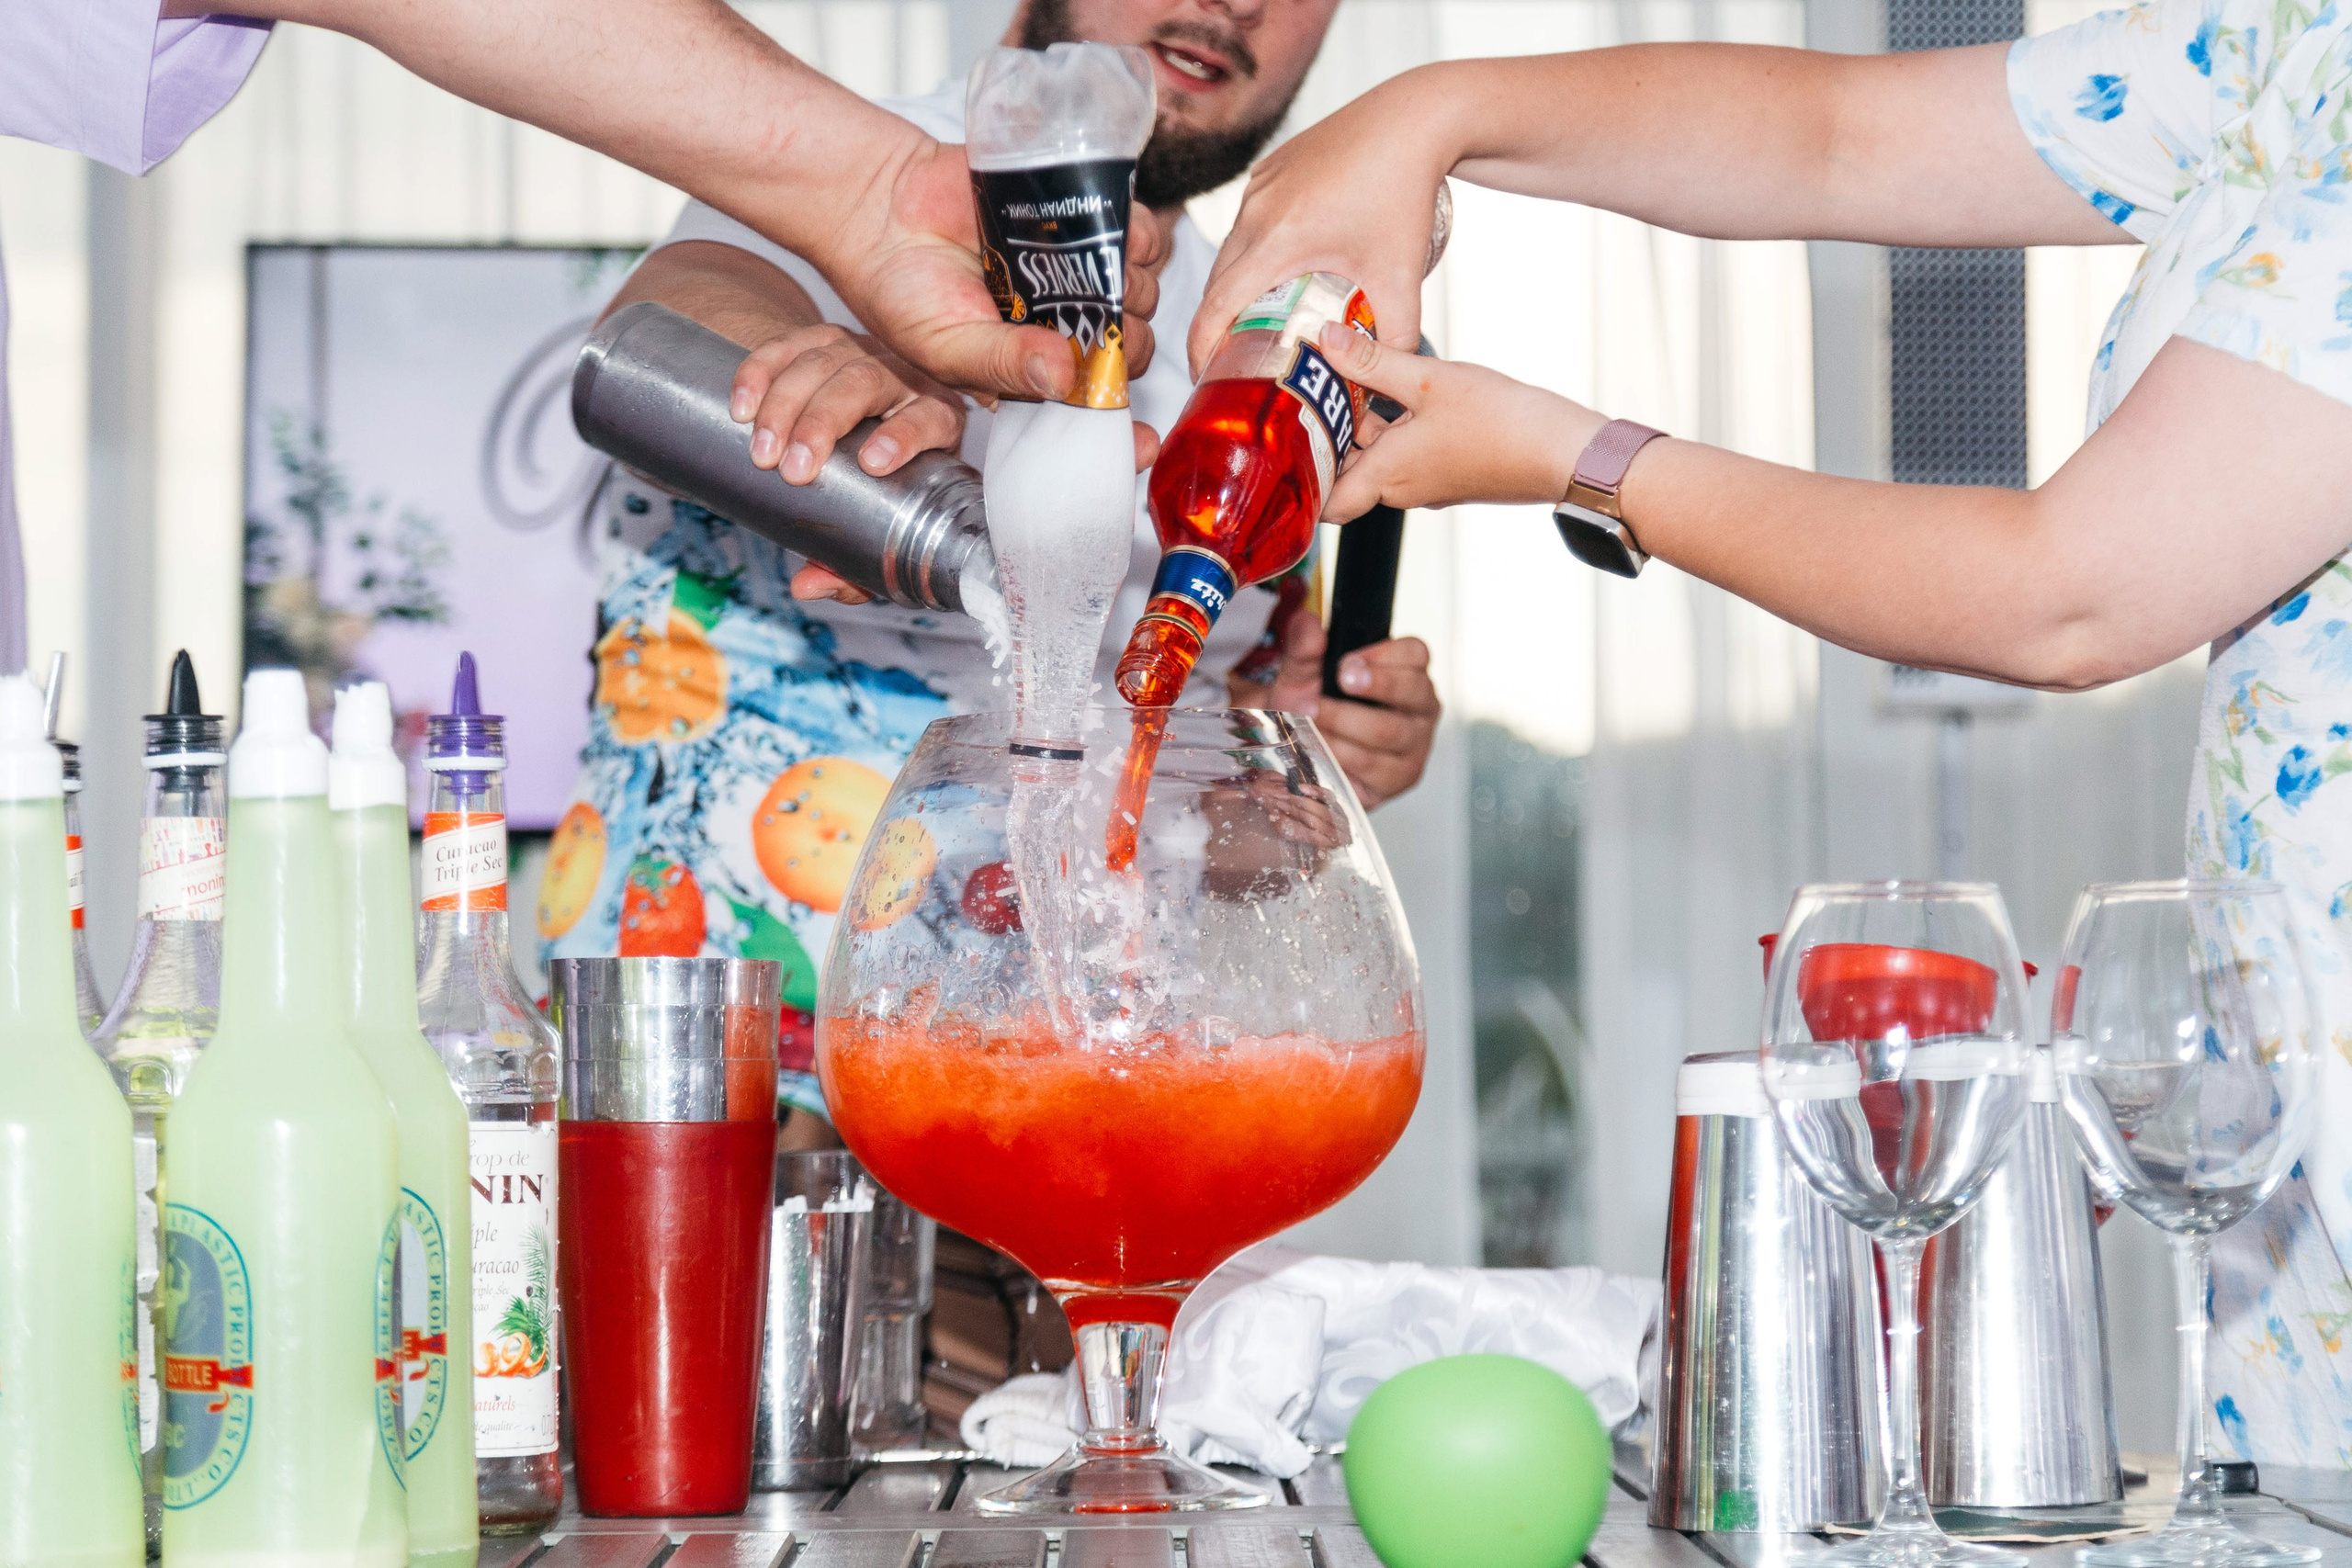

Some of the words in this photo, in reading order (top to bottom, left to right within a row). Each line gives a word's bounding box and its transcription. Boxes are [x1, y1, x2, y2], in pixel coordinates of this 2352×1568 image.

[1017, 245, 1123, 302] EVERVESS
[1298, 355, 1352, 478] ARE
[483, 855, 503, 872] Sec
[469, 1154, 503, 1175] rop
[509, 1150, 530, 1167] de
[469, 1174, 544, 1205] NIN
[403, 1202, 440, 1264] ASTIC
[473, 1395, 516, 1412] aturels
